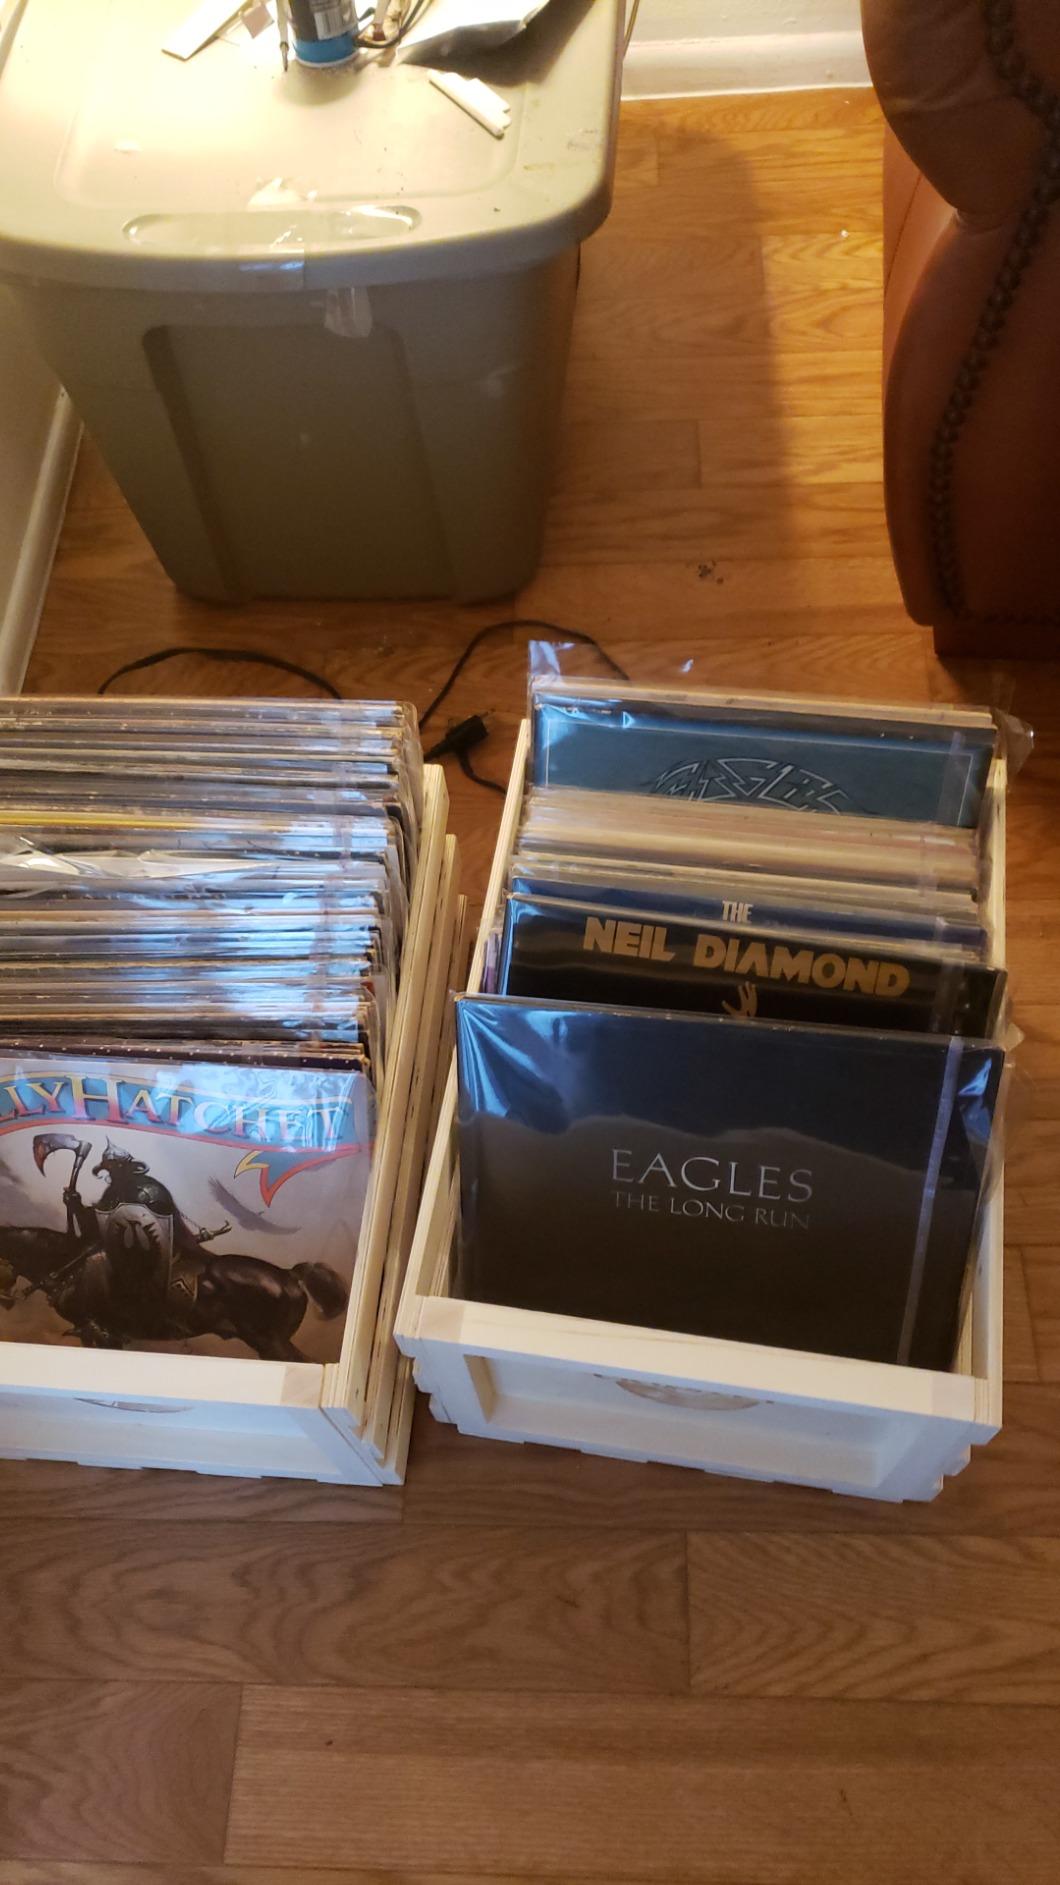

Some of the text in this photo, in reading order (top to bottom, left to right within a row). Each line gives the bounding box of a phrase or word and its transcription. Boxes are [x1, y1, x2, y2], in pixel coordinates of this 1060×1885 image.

[722, 900, 754, 923] THE
[583, 916, 911, 997] NEIL DIAMOND
[65, 1074, 346, 1143] HATCHET
[612, 1149, 814, 1203] EAGLES
[612, 1191, 812, 1230] THE LONG RUN
